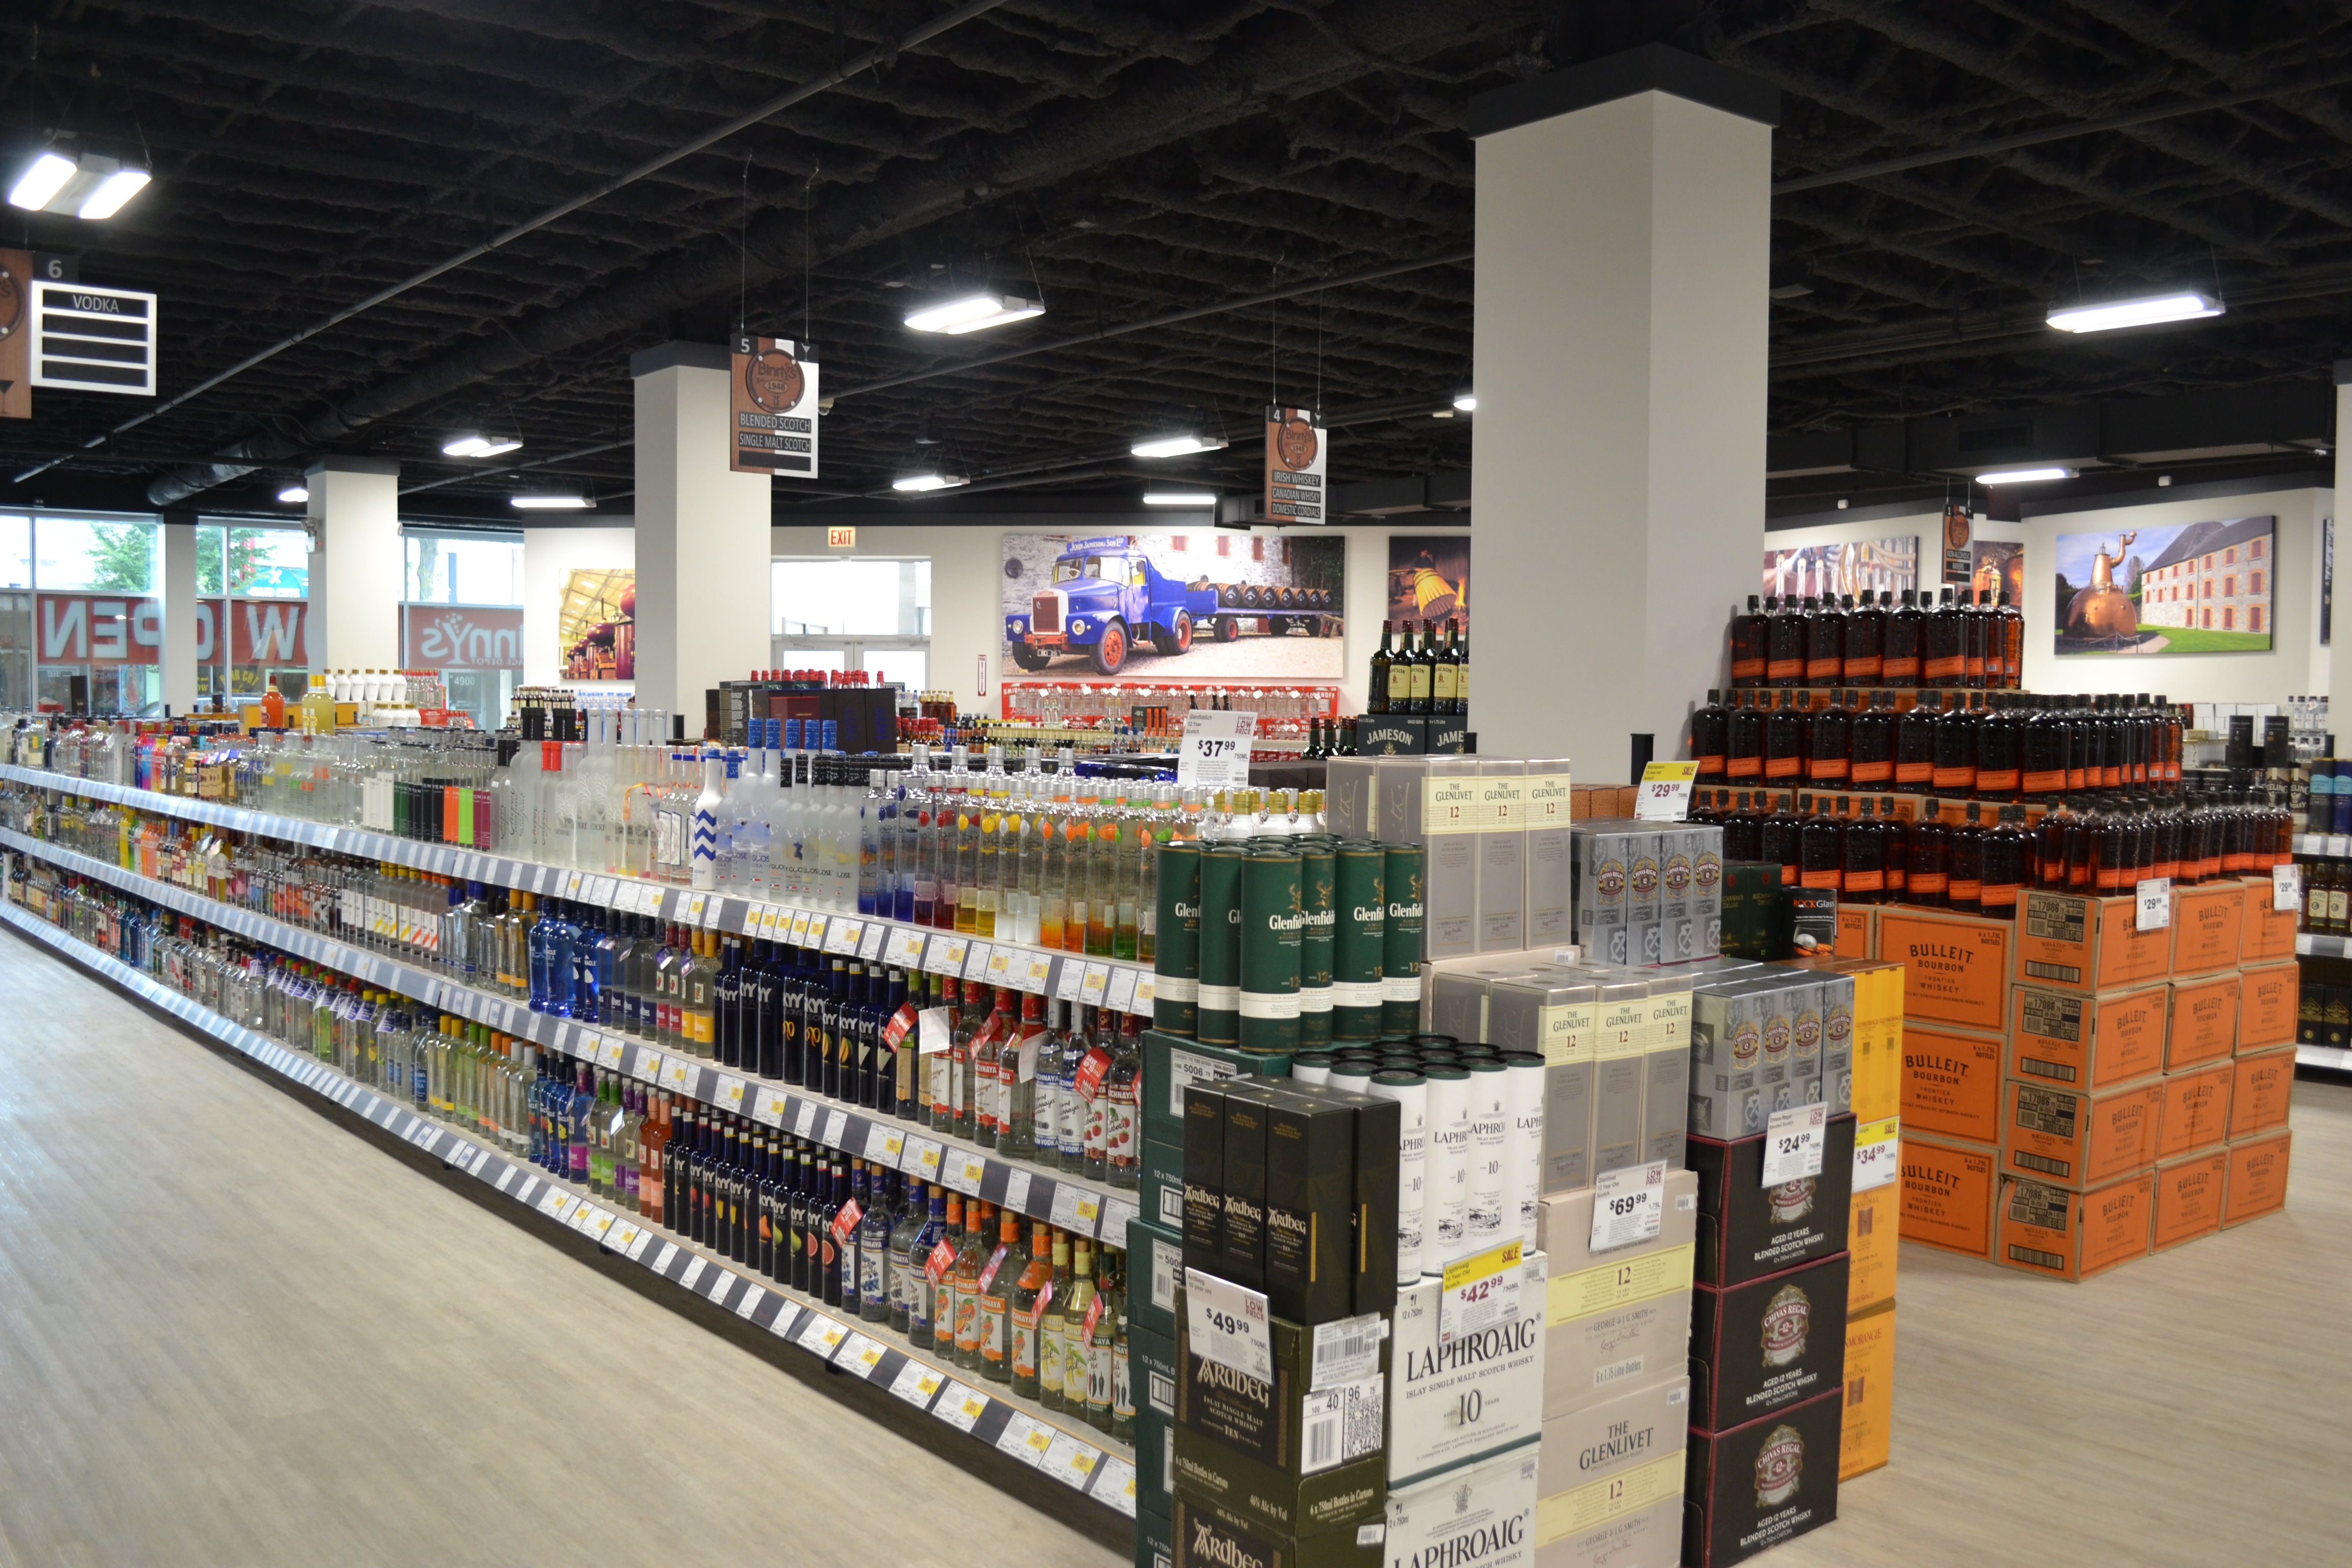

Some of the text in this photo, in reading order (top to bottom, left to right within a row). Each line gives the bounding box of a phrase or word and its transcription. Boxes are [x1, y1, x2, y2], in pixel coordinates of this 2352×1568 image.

[48, 260, 62, 278] 6
[73, 295, 119, 312] VODKA
[741, 338, 750, 353] 5
[767, 382, 786, 391] 1948
[741, 413, 811, 432] BLENDED SCOTCH
[1273, 409, 1280, 422] 4
[740, 433, 811, 451] SINGLE MALT SCOTCH
[1275, 472, 1319, 486] IRISH WHISKEY
[1272, 488, 1320, 502] CANADIAN WHISKY
[1272, 504, 1320, 518] DOMESTIC CORDIALS
[1948, 506, 1951, 515] 1
[831, 530, 852, 545] EXIT
[1947, 550, 1970, 559] NON-ALCOHOLIC
[1952, 562, 1965, 571] MIXERS
[454, 676, 475, 686] 4900
[1237, 720, 1253, 728] LOW
[1367, 729, 1412, 746] JAMESON
[1437, 730, 1464, 747] JAME
[1682, 766, 1695, 775] SALE
[1436, 791, 1473, 802] GLENLIVET
[1532, 788, 1566, 799] GLENLIVET
[1450, 806, 1460, 818] 12
[1546, 802, 1555, 814] 12
[2038, 901, 2060, 913] 17086
[2199, 905, 2228, 921] BULLEIT
[1981, 938, 2000, 946] BOTTLES
[1910, 944, 1974, 965] BULLEIT
[1409, 962, 1419, 973] 12
[1918, 960, 1964, 973] BOURBON
[1924, 975, 1955, 984] FRONTIER
[1920, 982, 1959, 993] WHISKEY
[1919, 992, 1942, 1000] STRAIGHT
[1943, 996, 1964, 1004] BOURBON
[1653, 1006, 1688, 1020] GLENLIVET
[1553, 1017, 1590, 1032] GLENLIVET
[1666, 1022, 1675, 1035] 12
[1796, 1023, 1809, 1034] CHIVAS
[1566, 1035, 1576, 1047] 12
[1086, 1054, 1098, 1065] SAVE
[1906, 1055, 1969, 1077] BULLEIT
[1184, 1064, 1204, 1077] 5006
[1810, 1110, 1824, 1120] LOW
[2112, 1105, 2144, 1125] BULLEIT
[1884, 1122, 1896, 1135] SALE
[1488, 1160, 1498, 1174] 10
[1647, 1169, 1662, 1179] LOW
[1598, 1175, 1616, 1184] Glenlivet
[1646, 1177, 1662, 1186] PRICE
[2177, 1172, 2209, 1192] BULLEIT
[1771, 1227, 1809, 1245] AGED 12 YEARS
[1754, 1233, 1824, 1261] BLENDED SCOTCH WHISKY
[1502, 1246, 1519, 1263] SALE
[1446, 1262, 1469, 1275] Laphroaig
[1188, 1273, 1205, 1286] Ardbeg
[1452, 1272, 1462, 1281] Year
[1616, 1266, 1631, 1286] 12
[1503, 1282, 1520, 1292] 750ML
[1245, 1298, 1264, 1313] LOW
[1245, 1310, 1264, 1321] PRICE
[1594, 1309, 1649, 1332] GEORGE SMITH
[1764, 1303, 1807, 1328] CHIVAS REGAL
[1406, 1318, 1536, 1383] LAPHROAIG
[1614, 1360, 1641, 1377] Litre Bottles
[1406, 1355, 1535, 1399] ISLAY SINGLE MALT SCOTCH WHISKY
[1349, 1386, 1360, 1402] 96
[1327, 1394, 1339, 1410] 40
[1458, 1388, 1482, 1426] 10
[1222, 1402, 1264, 1427] SINGLE MALT
[1360, 1405, 1381, 1419] 3262
[1224, 1425, 1239, 1440] TEN
[1608, 1420, 1629, 1438] THE
[1347, 1434, 1381, 1456] NC-34420
[1580, 1427, 1654, 1471] GLENLIVET
[1757, 1443, 1801, 1469] CHIVAS REGAL
[1609, 1480, 1623, 1500] 12
[1333, 1487, 1374, 1509] Bottles Cartons
[1250, 1494, 1287, 1521] 46% Alc by Vol
